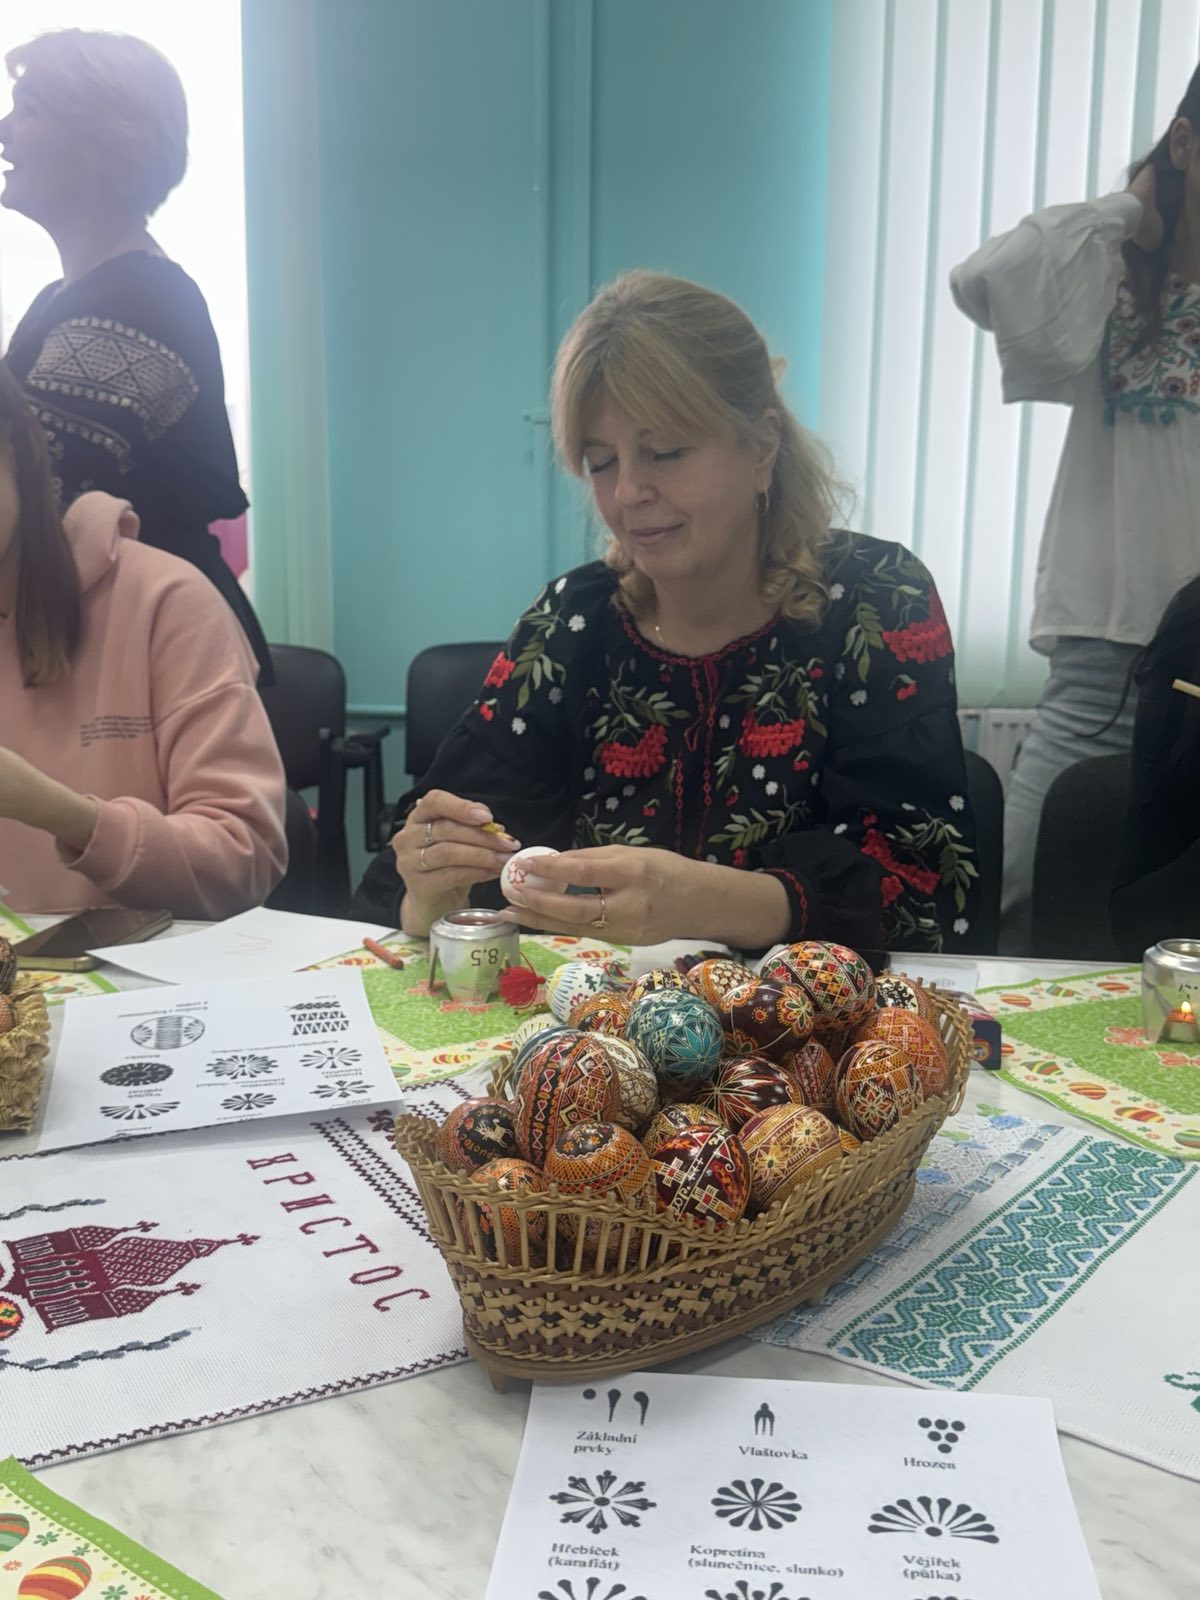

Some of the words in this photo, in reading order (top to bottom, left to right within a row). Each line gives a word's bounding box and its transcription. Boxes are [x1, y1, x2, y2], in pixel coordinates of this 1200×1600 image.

[471, 948, 499, 966] 8.5
[576, 1430, 638, 1444] Základní
[573, 1444, 614, 1456] prvky
[738, 1445, 808, 1460] Vlaštovka
[904, 1457, 957, 1470] Hrozen
[551, 1542, 620, 1557] Hřebíček
[690, 1544, 766, 1559] Kopretina
[547, 1556, 620, 1571] (karafiát)
[902, 1554, 961, 1568] Vějířek
[785, 1563, 844, 1578] slunko)
[902, 1568, 962, 1583] (půlka)
